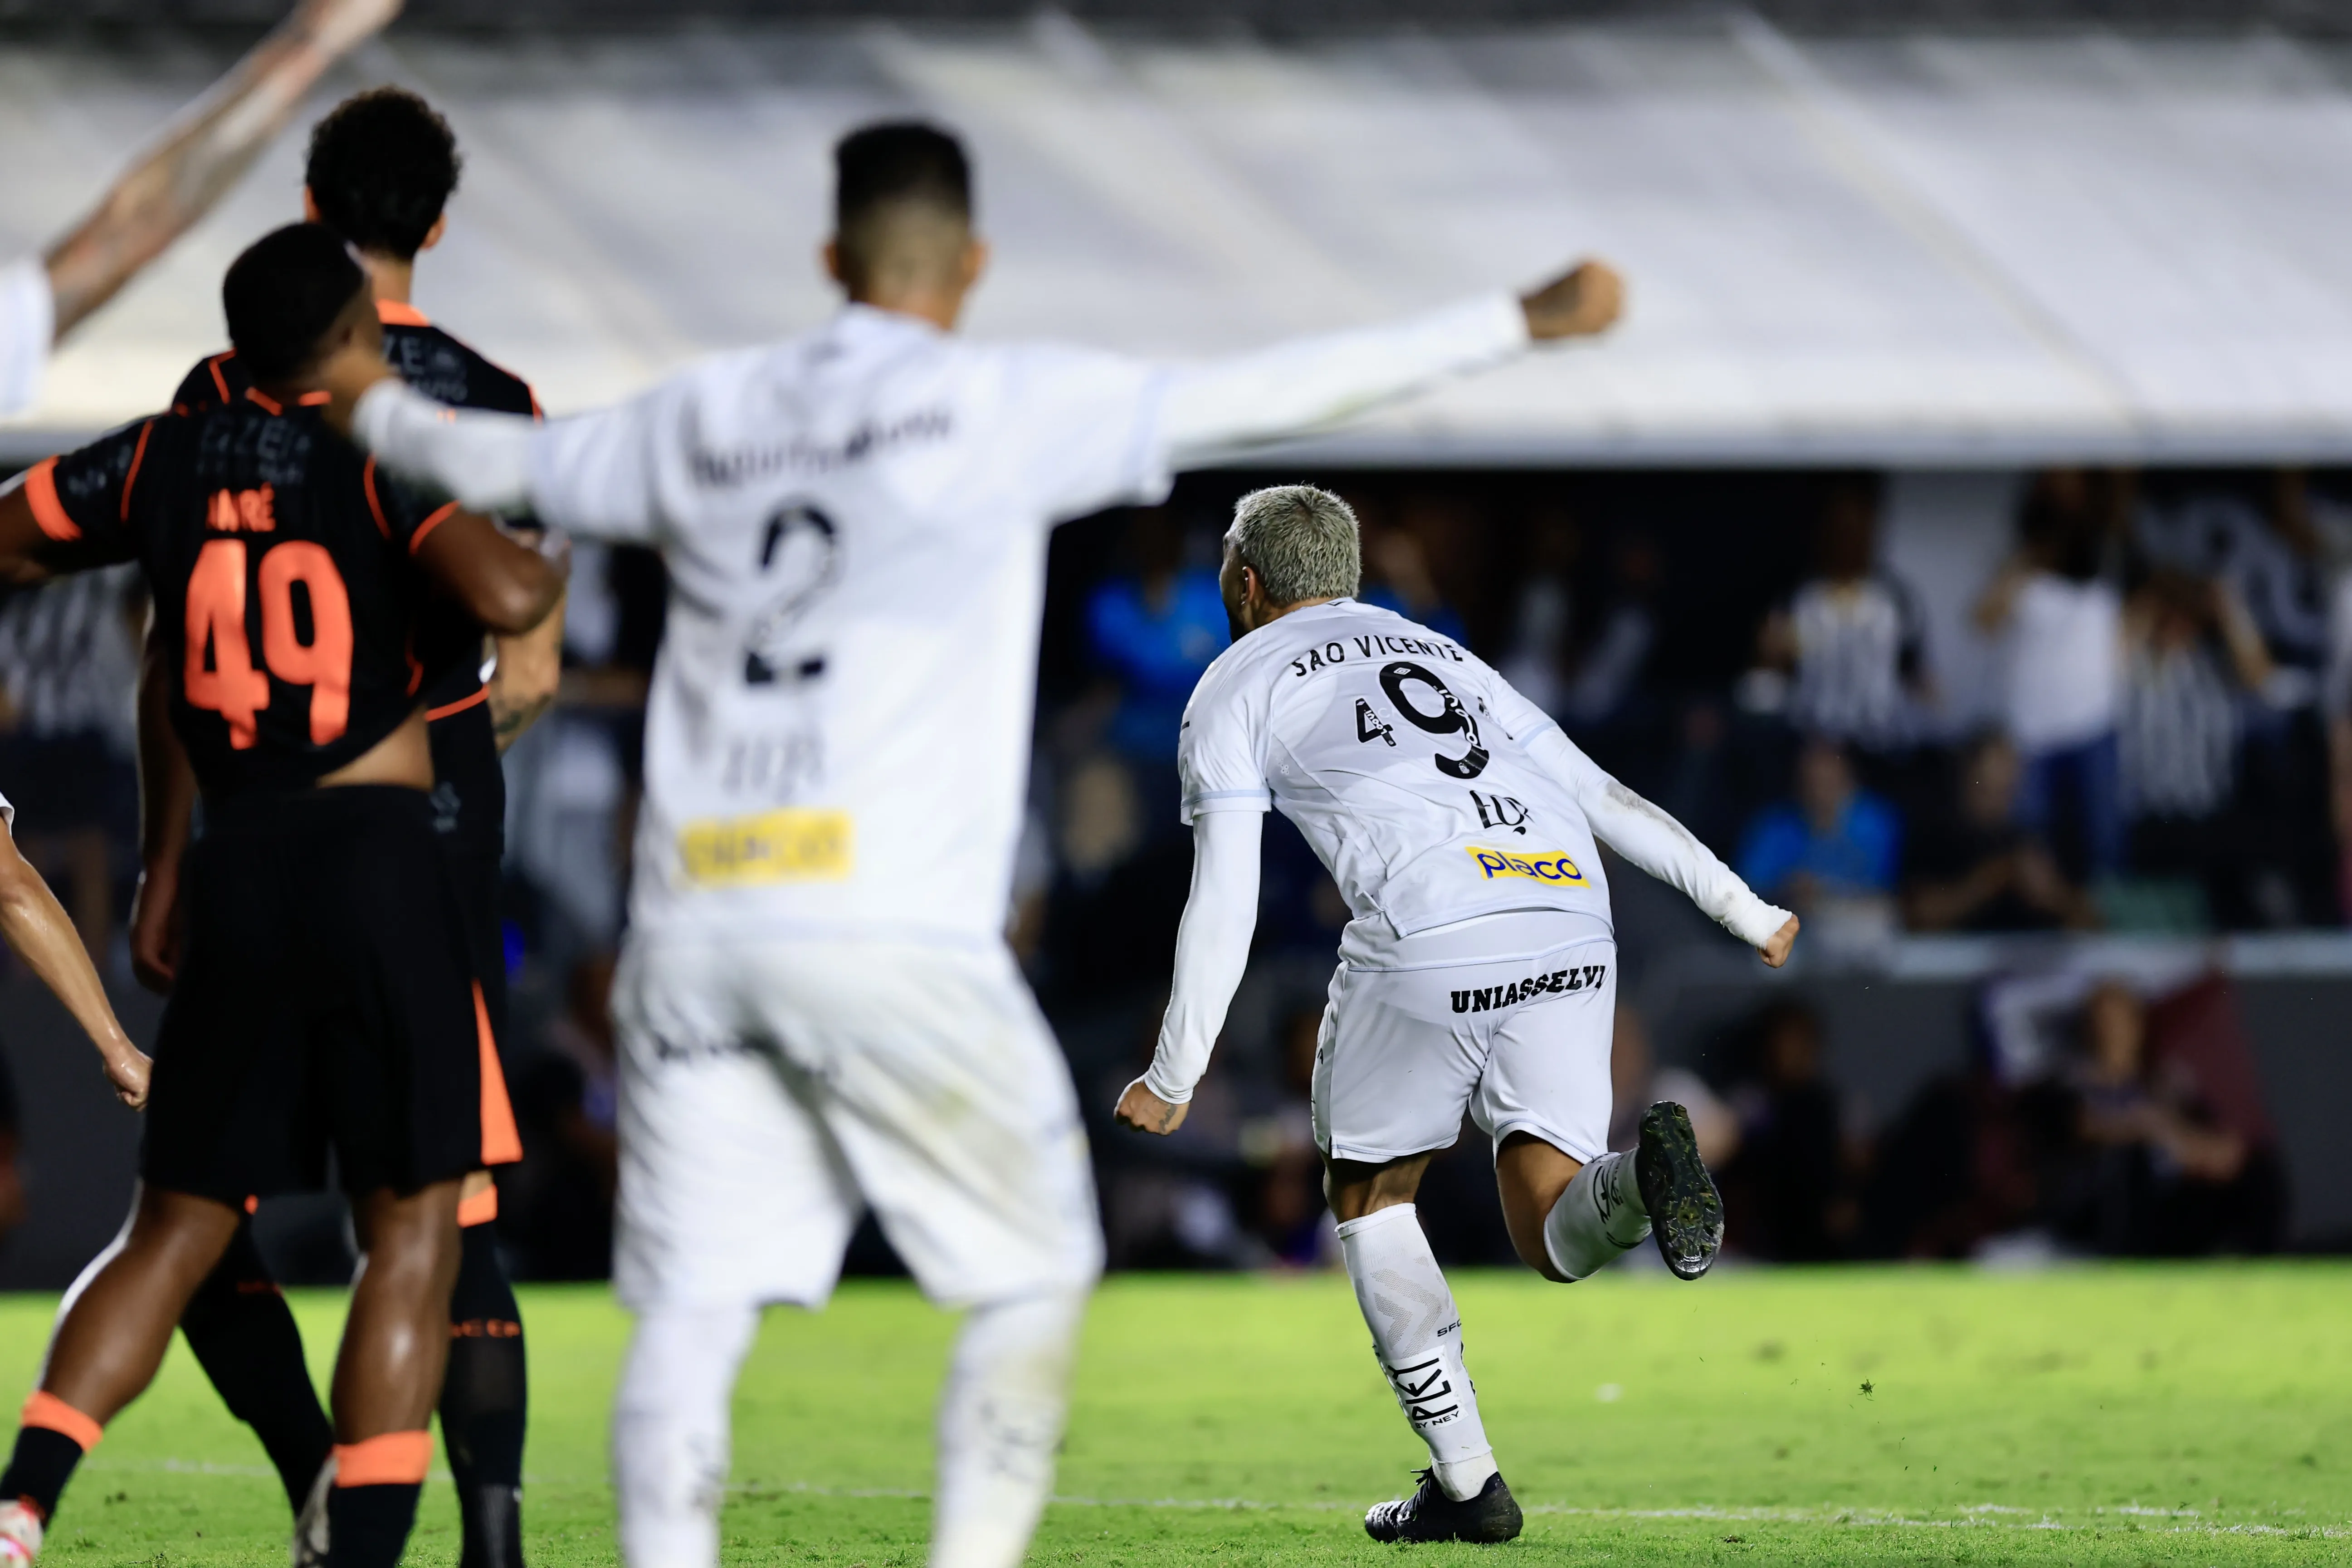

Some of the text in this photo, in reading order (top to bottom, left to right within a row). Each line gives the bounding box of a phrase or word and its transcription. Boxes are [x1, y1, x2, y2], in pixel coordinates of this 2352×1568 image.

[744, 494, 841, 686] 2
[184, 539, 354, 749] 49
[1353, 635, 1464, 662] VICENTE
[1477, 851, 1582, 880] placo
[1451, 965, 1605, 1013] UNIASSELVI
[1432, 1411, 1459, 1426] NEY
